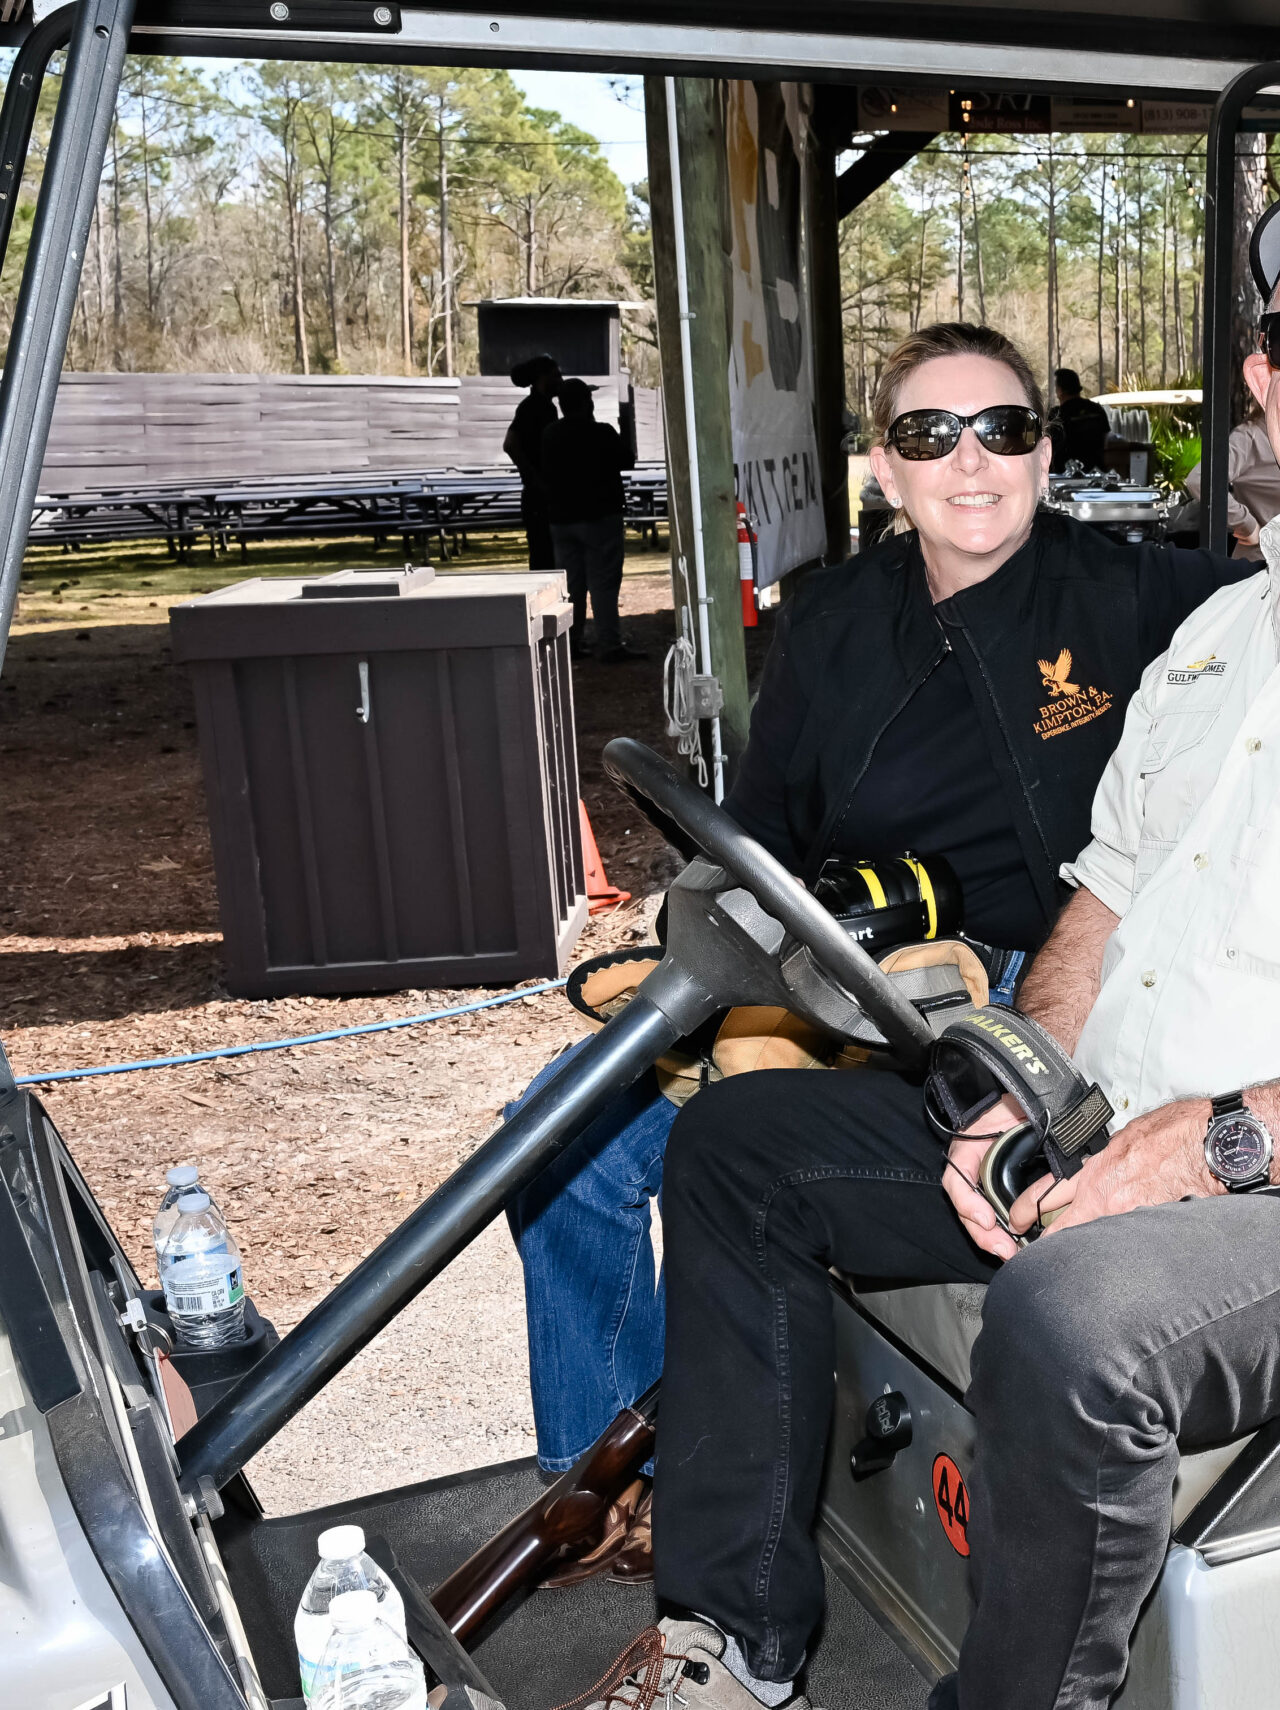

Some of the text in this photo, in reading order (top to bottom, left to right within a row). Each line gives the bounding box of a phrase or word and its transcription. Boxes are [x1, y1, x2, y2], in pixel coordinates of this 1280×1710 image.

[1167, 672, 1200, 683] GULFW
[1032, 701, 1096, 734] KIMPTON,
[1039, 685, 1099, 719] BROWN &
[848, 926, 874, 941] art
[938, 1466, 969, 1534] 44
